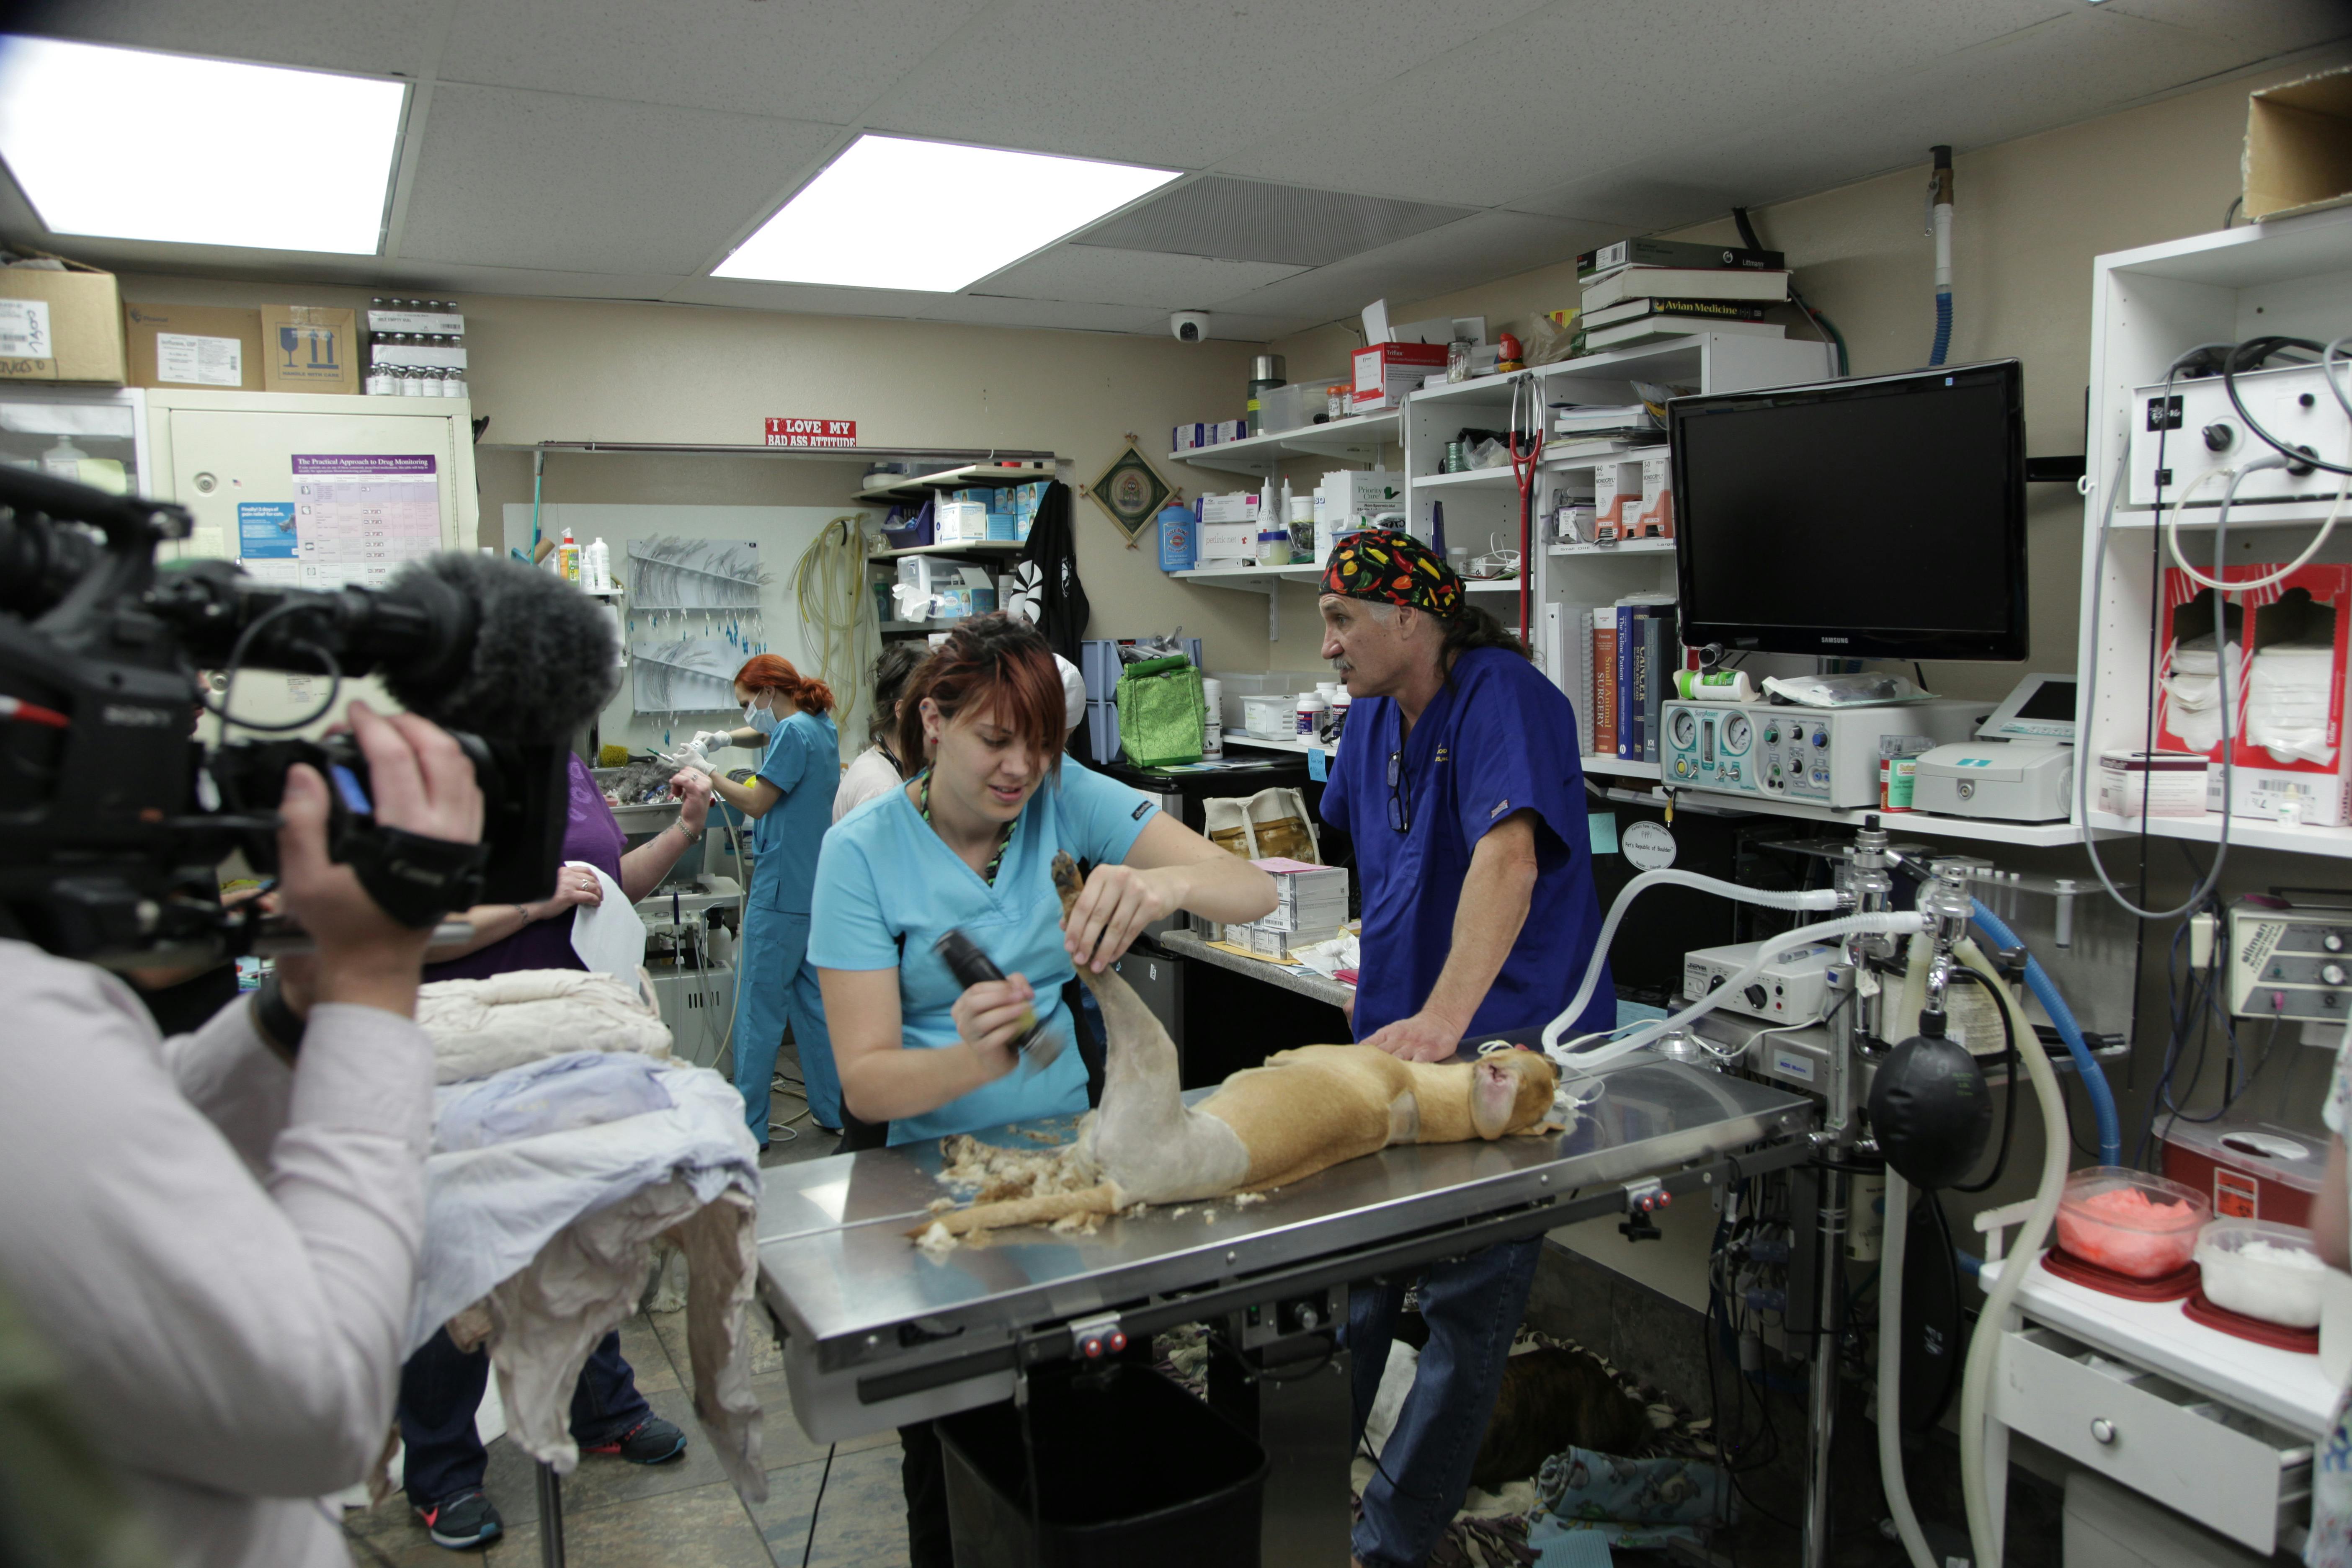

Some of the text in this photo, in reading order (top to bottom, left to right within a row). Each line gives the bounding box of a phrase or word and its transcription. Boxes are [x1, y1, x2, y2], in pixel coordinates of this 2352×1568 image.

[1665, 301, 1738, 315] Avian Medicine
[773, 419, 850, 434] I LOVE MY
[768, 434, 855, 447] BAD ASS ATTITUDE
[339, 458, 369, 467] Approach
[395, 458, 428, 467] Monitoring
[1166, 528, 1189, 536] GOLD BOND
